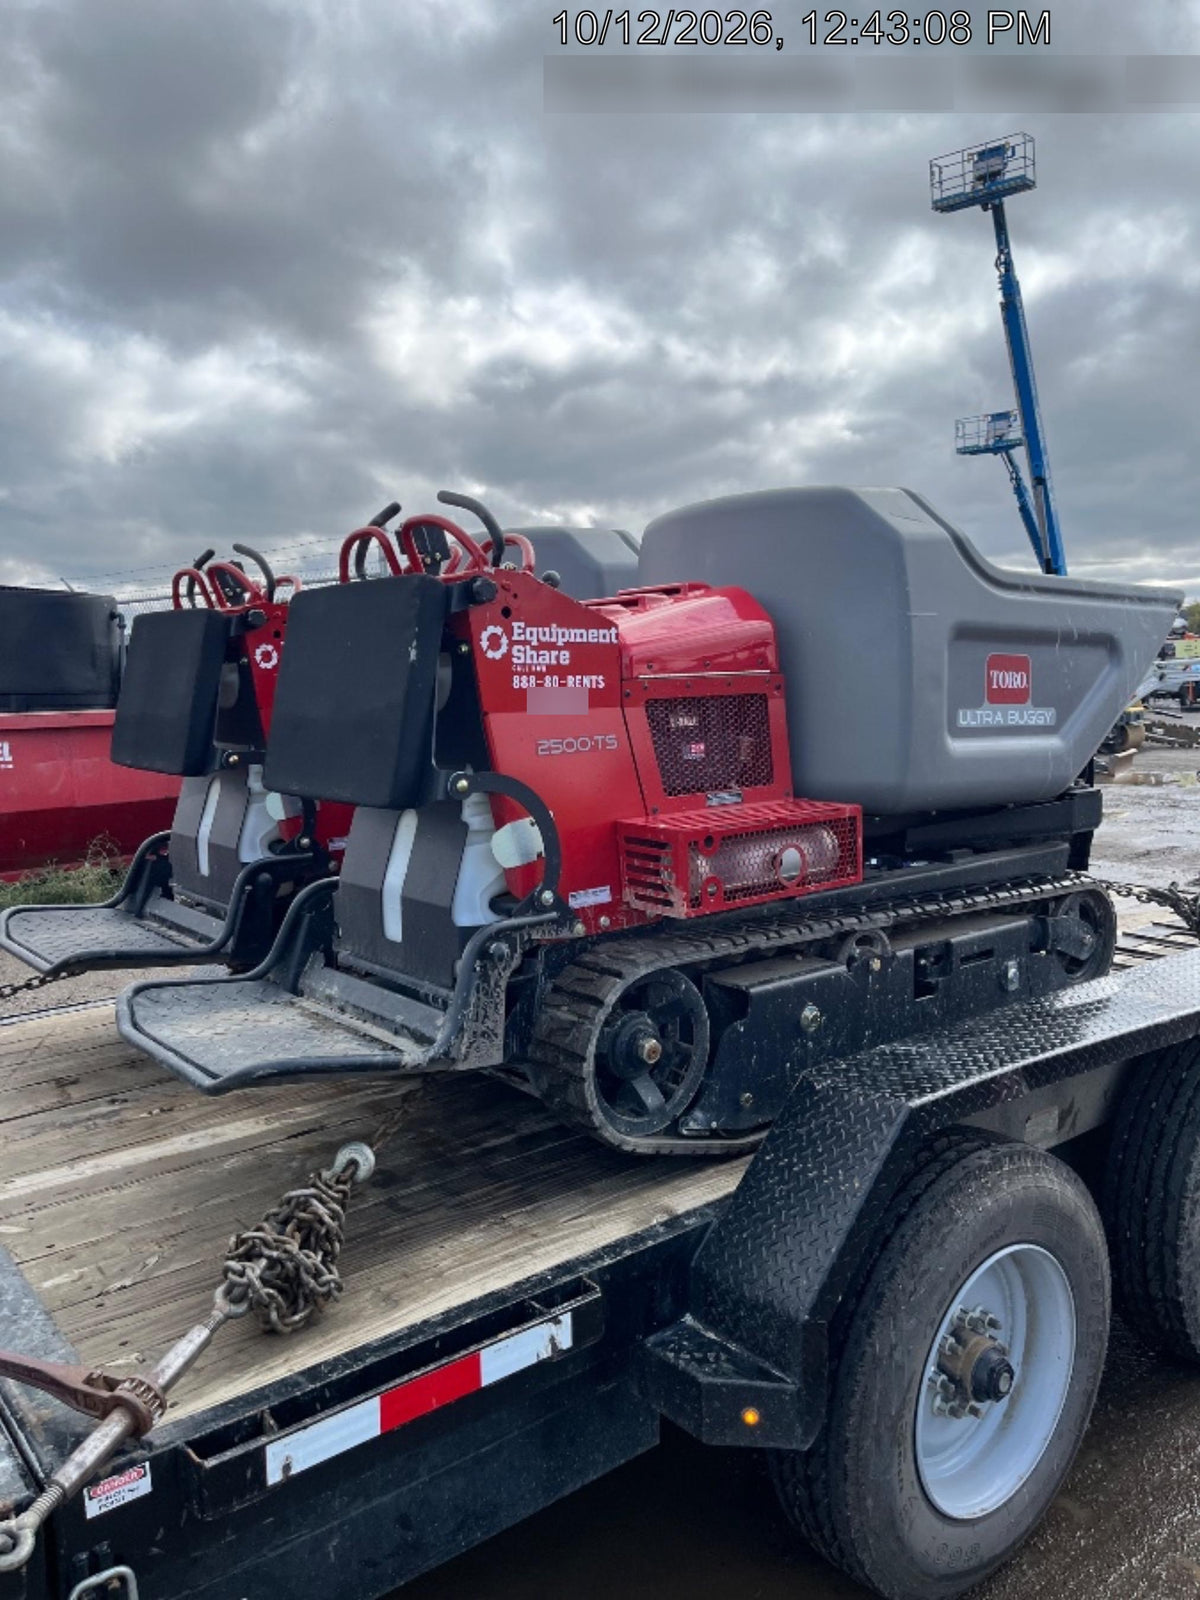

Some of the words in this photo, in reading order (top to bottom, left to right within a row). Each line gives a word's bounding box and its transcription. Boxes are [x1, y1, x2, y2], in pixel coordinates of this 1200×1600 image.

[511, 621, 618, 646] Equipment
[511, 645, 570, 665] Share
[512, 675, 606, 689] 888-80-RENTS
[990, 670, 1028, 688] TORO
[959, 710, 1003, 725] ULTRA
[1007, 710, 1052, 725] BUGGY
